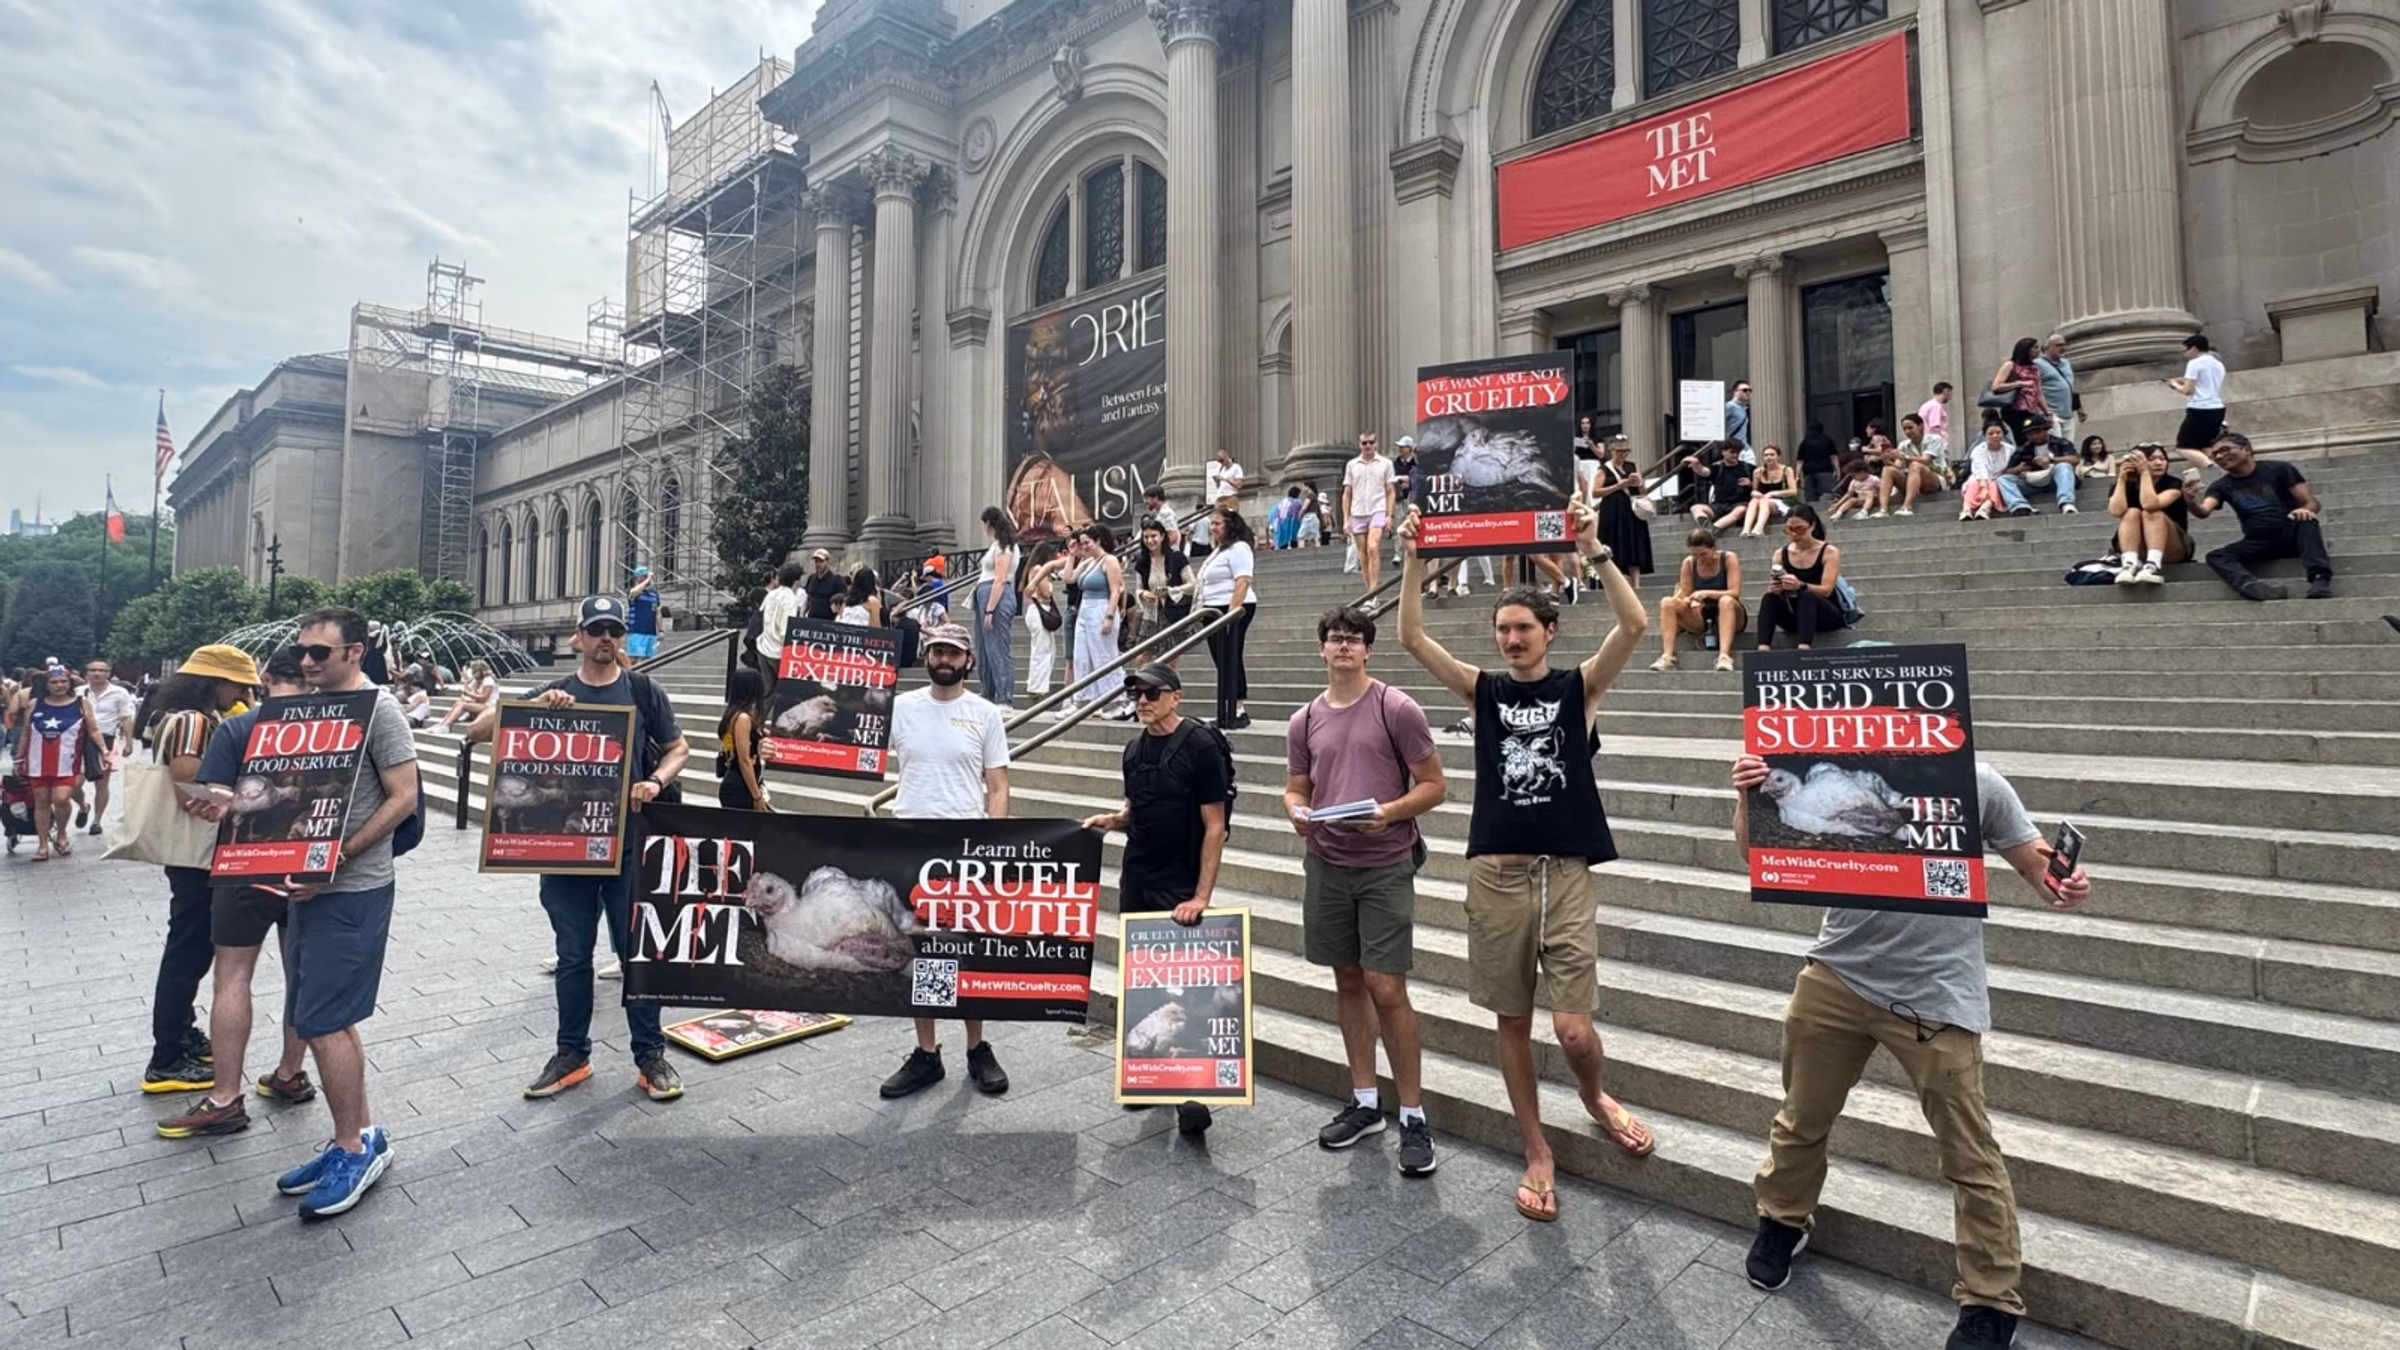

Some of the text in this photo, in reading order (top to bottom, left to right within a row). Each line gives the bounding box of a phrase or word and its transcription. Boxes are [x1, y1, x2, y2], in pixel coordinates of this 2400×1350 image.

[1646, 112, 1714, 160] THE
[1646, 147, 1716, 198] MET
[1426, 380, 1448, 393] WE
[1450, 376, 1492, 390] WANT
[1530, 367, 1564, 382] NOT
[1102, 382, 1167, 408] Between Fact
[1425, 382, 1564, 417] CRUELTY
[1102, 401, 1159, 423] and Fantasy
[1427, 474, 1463, 493] THE
[1427, 493, 1464, 514] MET
[1424, 518, 1519, 531] MetWithCruelty.com
[842, 632, 863, 645] THE
[863, 638, 896, 649] MET'S
[791, 640, 894, 669] UGLIEST
[786, 660, 892, 690] EXHIBIT
[1754, 665, 1953, 682] THE MET SERVES BIRDS
[1756, 680, 1955, 712] BRED TO
[282, 705, 315, 721] FINE
[529, 717, 565, 731] FINE
[856, 713, 885, 730] THE
[251, 718, 361, 757] FOUL
[852, 729, 884, 746] MET
[1757, 714, 1960, 749] SUFFER
[504, 730, 620, 763] FOUL
[247, 754, 353, 773] FOOD SERVICE
[502, 761, 618, 777] FOOD SERVICE
[311, 798, 342, 818] THE
[582, 801, 614, 818] THE
[1904, 796, 1964, 824] THE
[304, 818, 339, 837] MET
[580, 817, 613, 834] MET
[962, 838, 1052, 859] Learn the
[1905, 824, 1967, 851] MET
[642, 835, 755, 902] THE
[1761, 855, 1899, 873] MetWithCruelty.com
[918, 858, 1093, 900] CRUEL
[917, 898, 1092, 937] TRUTH
[628, 901, 758, 966] MET
[1181, 929, 1202, 940] THE
[1205, 926, 1238, 938] MET'S
[921, 936, 1087, 959] about The Met at
[1131, 940, 1238, 964] UGLIEST
[1131, 965, 1238, 989] EXHIBIT
[1207, 1018, 1239, 1036] THE
[1208, 1037, 1240, 1055] MET
